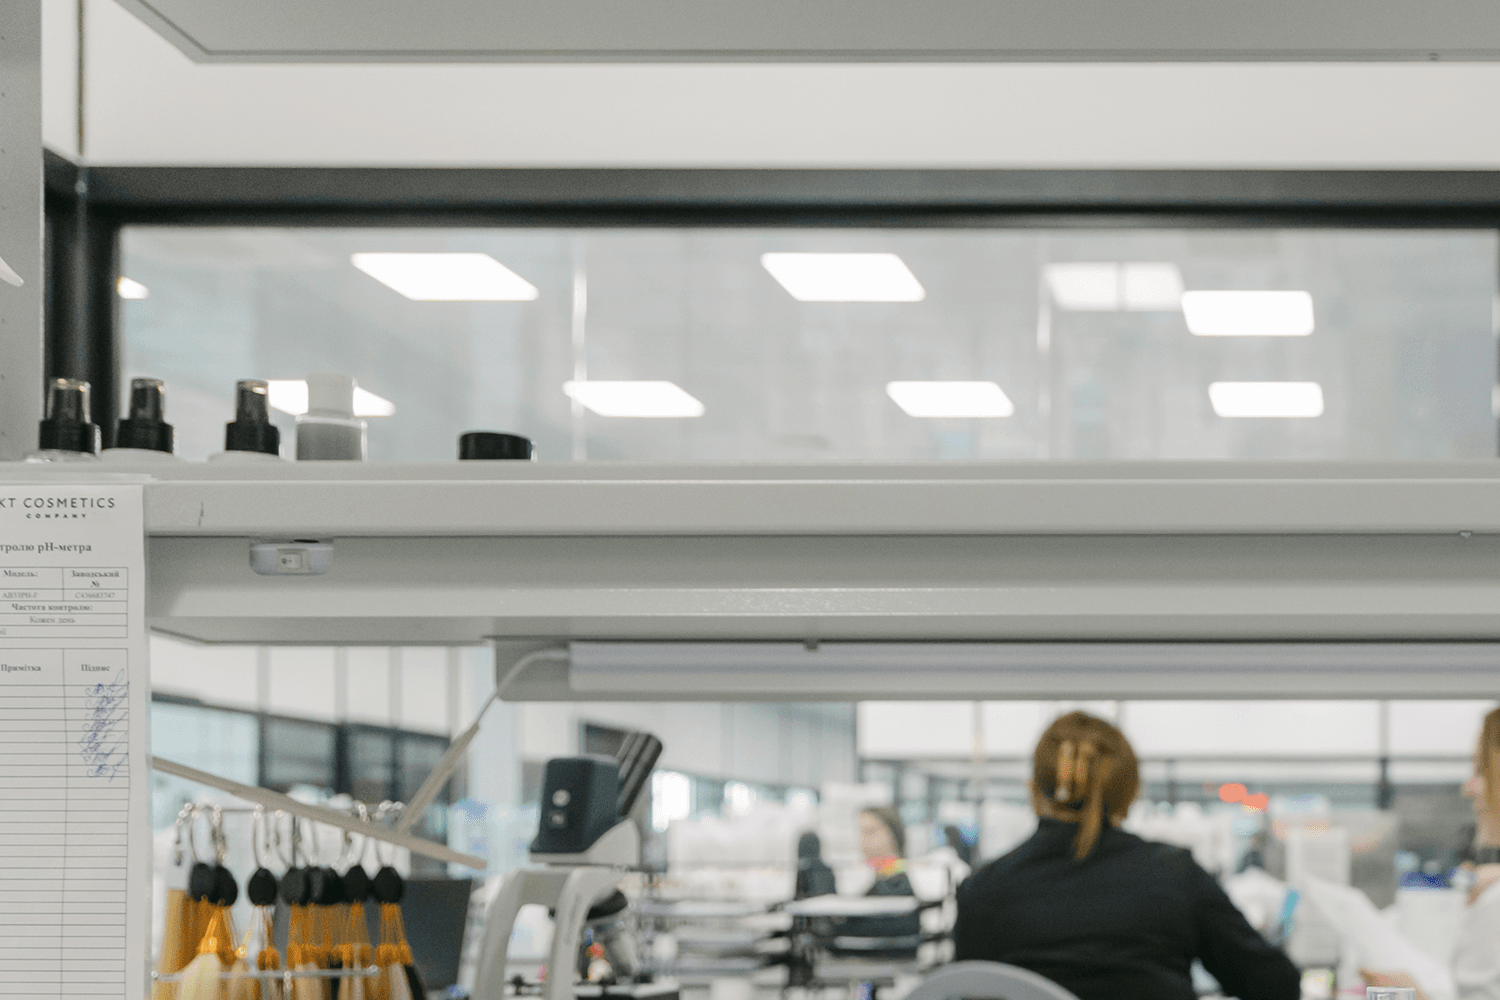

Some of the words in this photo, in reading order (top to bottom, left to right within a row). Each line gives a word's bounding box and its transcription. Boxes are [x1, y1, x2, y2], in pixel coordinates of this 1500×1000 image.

[23, 497, 115, 509] COSMETICS
[3, 569, 39, 578] Модель:
[70, 569, 120, 578] Заводський
[11, 602, 46, 611] Частота
